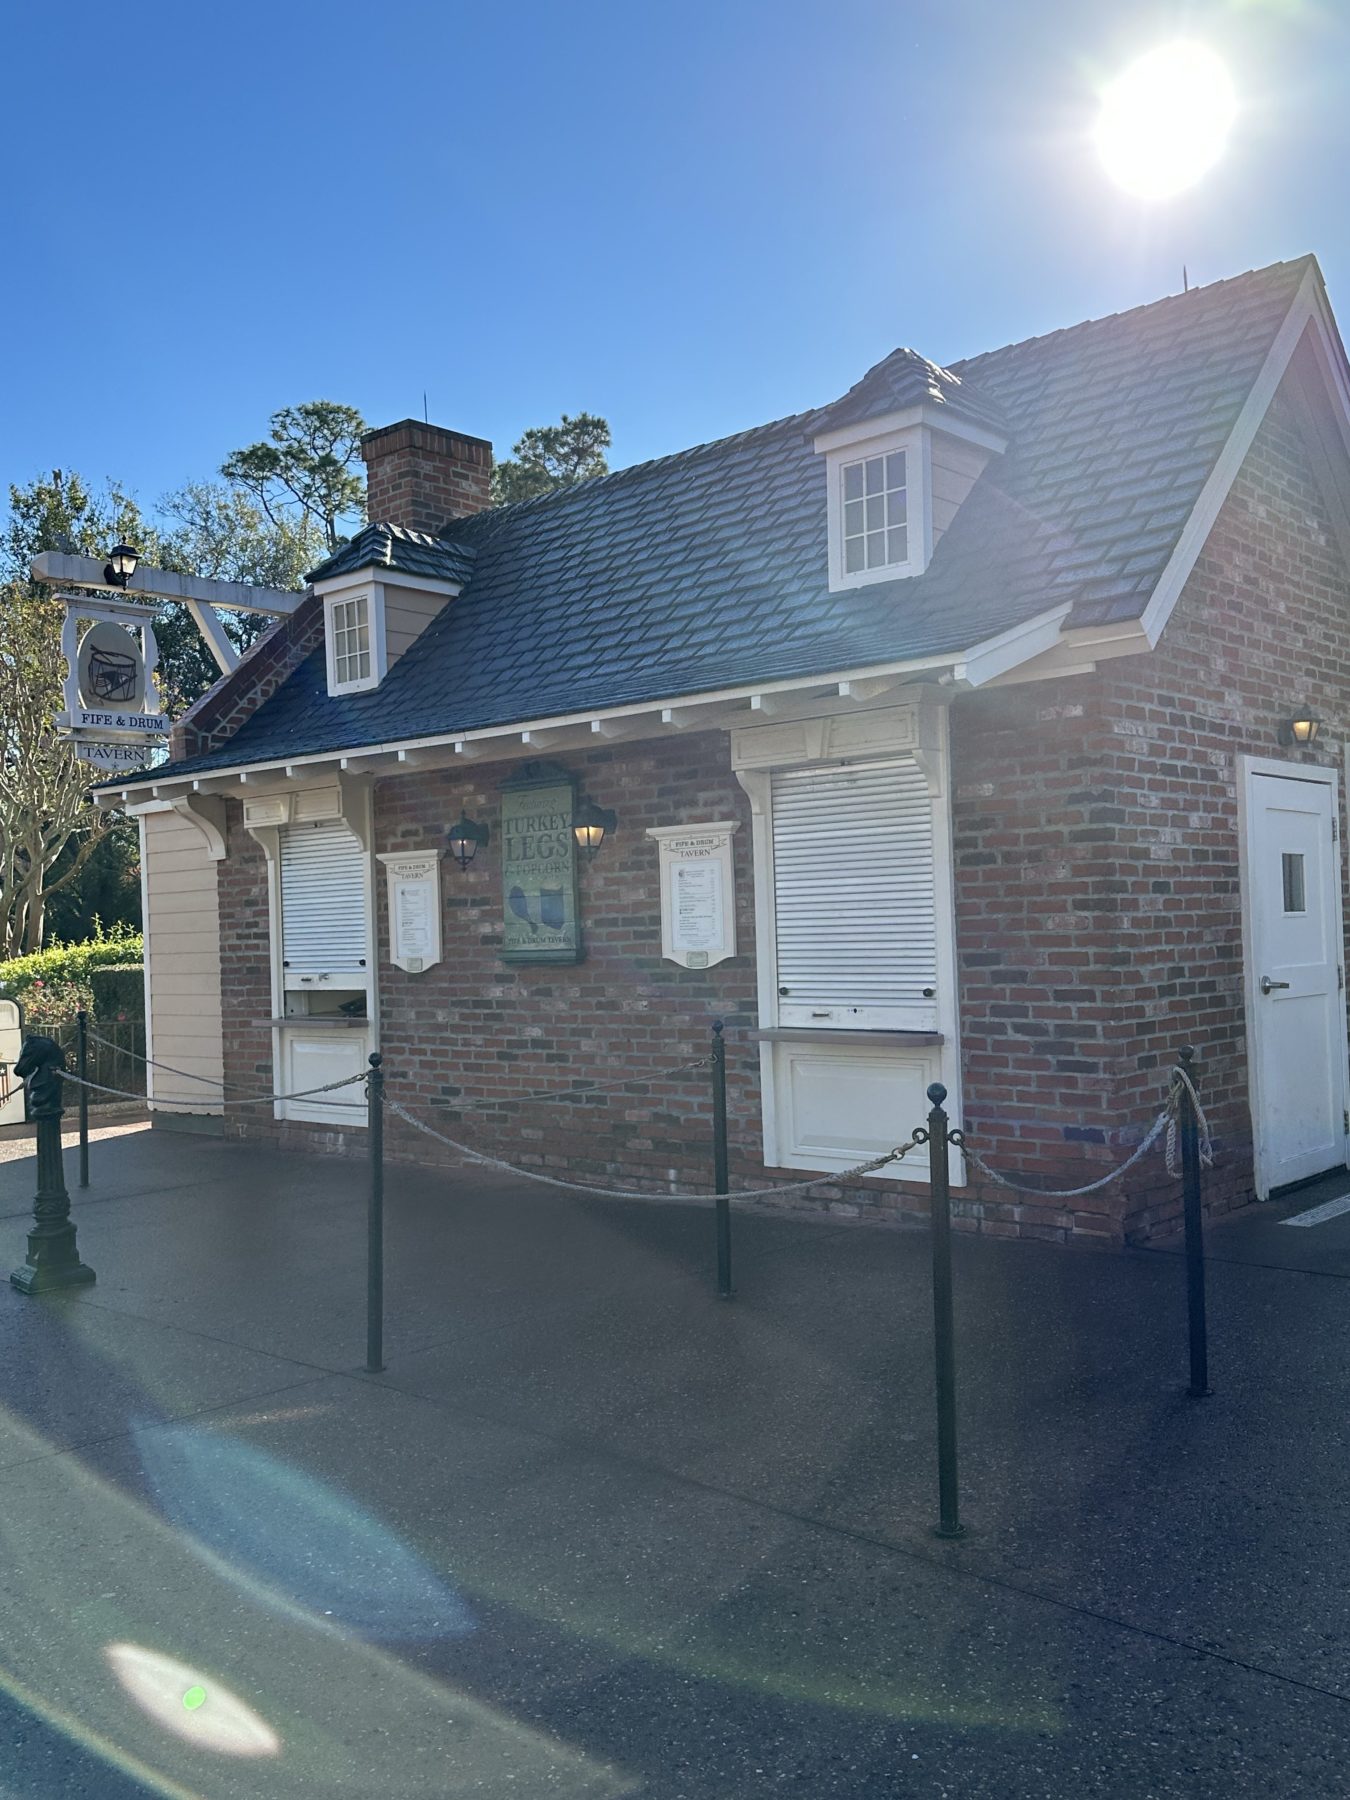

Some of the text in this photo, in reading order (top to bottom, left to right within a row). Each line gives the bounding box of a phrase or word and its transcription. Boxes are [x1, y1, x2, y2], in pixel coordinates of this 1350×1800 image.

[82, 713, 163, 729] FIFE & DRUM
[84, 747, 145, 761] TAVERN
[503, 812, 571, 835] TURKEY
[504, 832, 569, 862] LEGS
[680, 848, 711, 857] TAVERN
[401, 872, 424, 880] TAVERN
[516, 860, 570, 876] POPCORN
